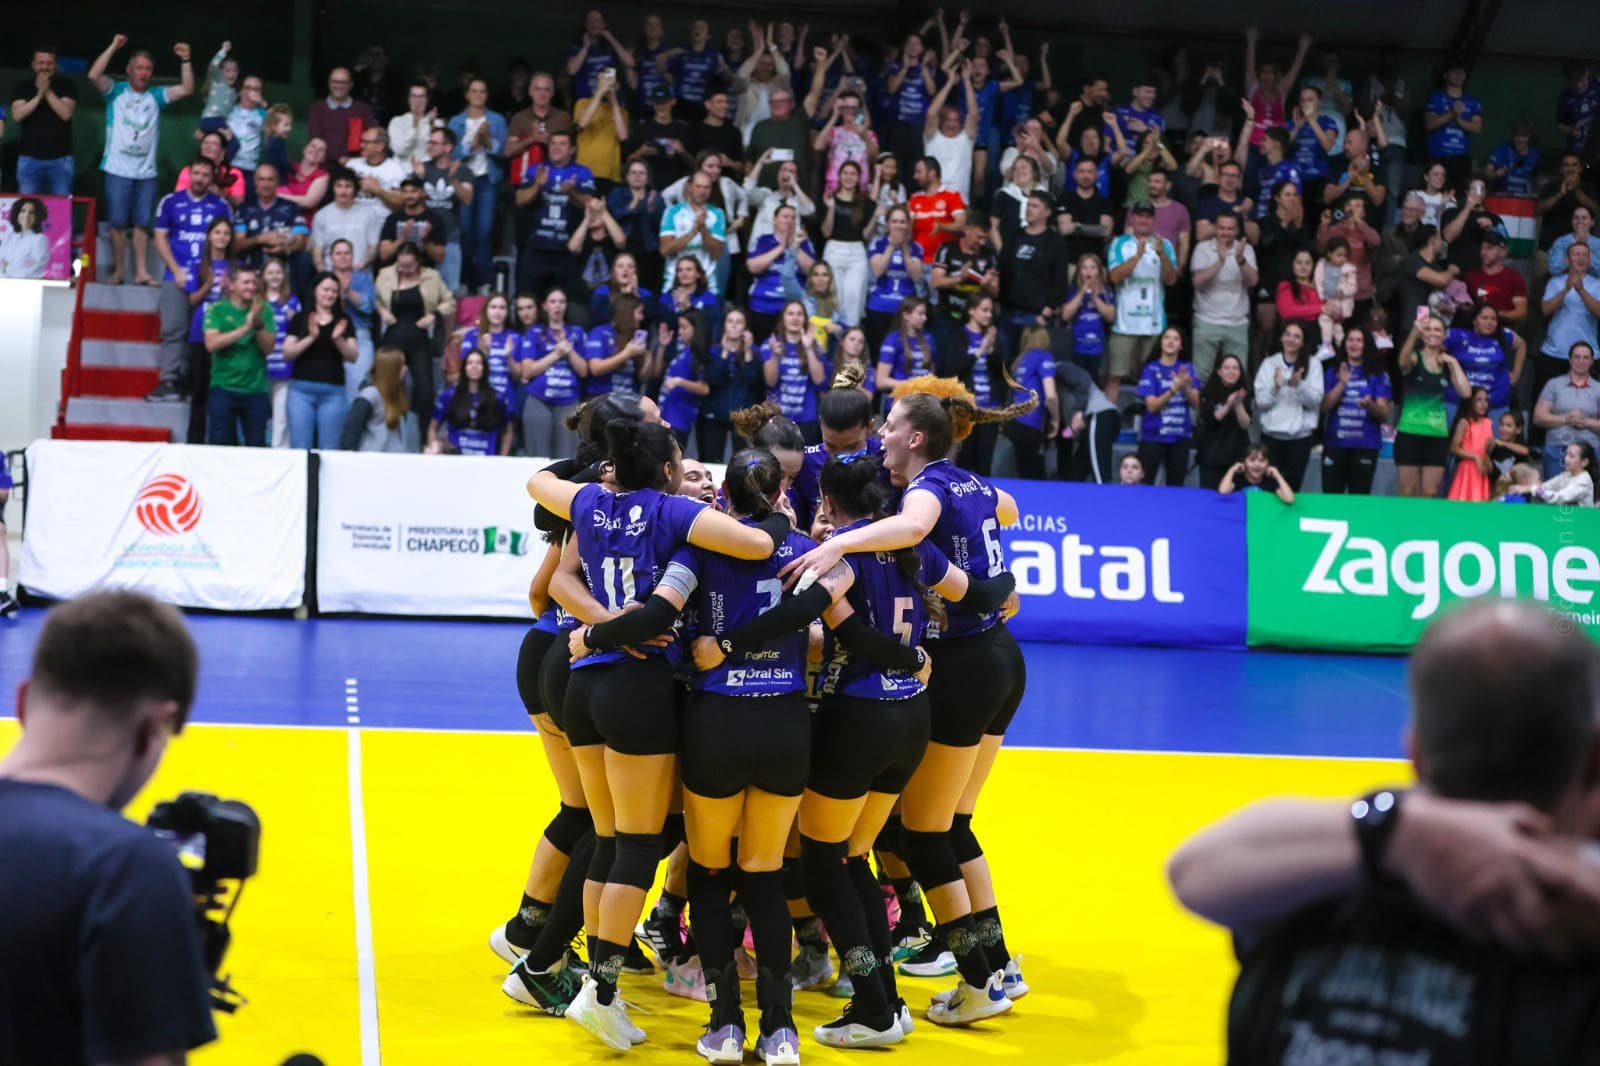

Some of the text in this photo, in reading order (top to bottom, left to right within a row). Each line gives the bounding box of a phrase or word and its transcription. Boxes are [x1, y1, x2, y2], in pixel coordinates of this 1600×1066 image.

[407, 536, 479, 553] CHAPECÓ
[408, 526, 479, 536] PREFEITURA DE
[981, 518, 1005, 578] 6
[1000, 514, 1068, 533] ACIAS
[601, 557, 635, 612] 11
[1009, 534, 1185, 603] atal
[1299, 517, 1600, 620] Zagone
[893, 597, 914, 647] 5
[746, 668, 772, 679] Oral
[773, 668, 793, 679] Sin
